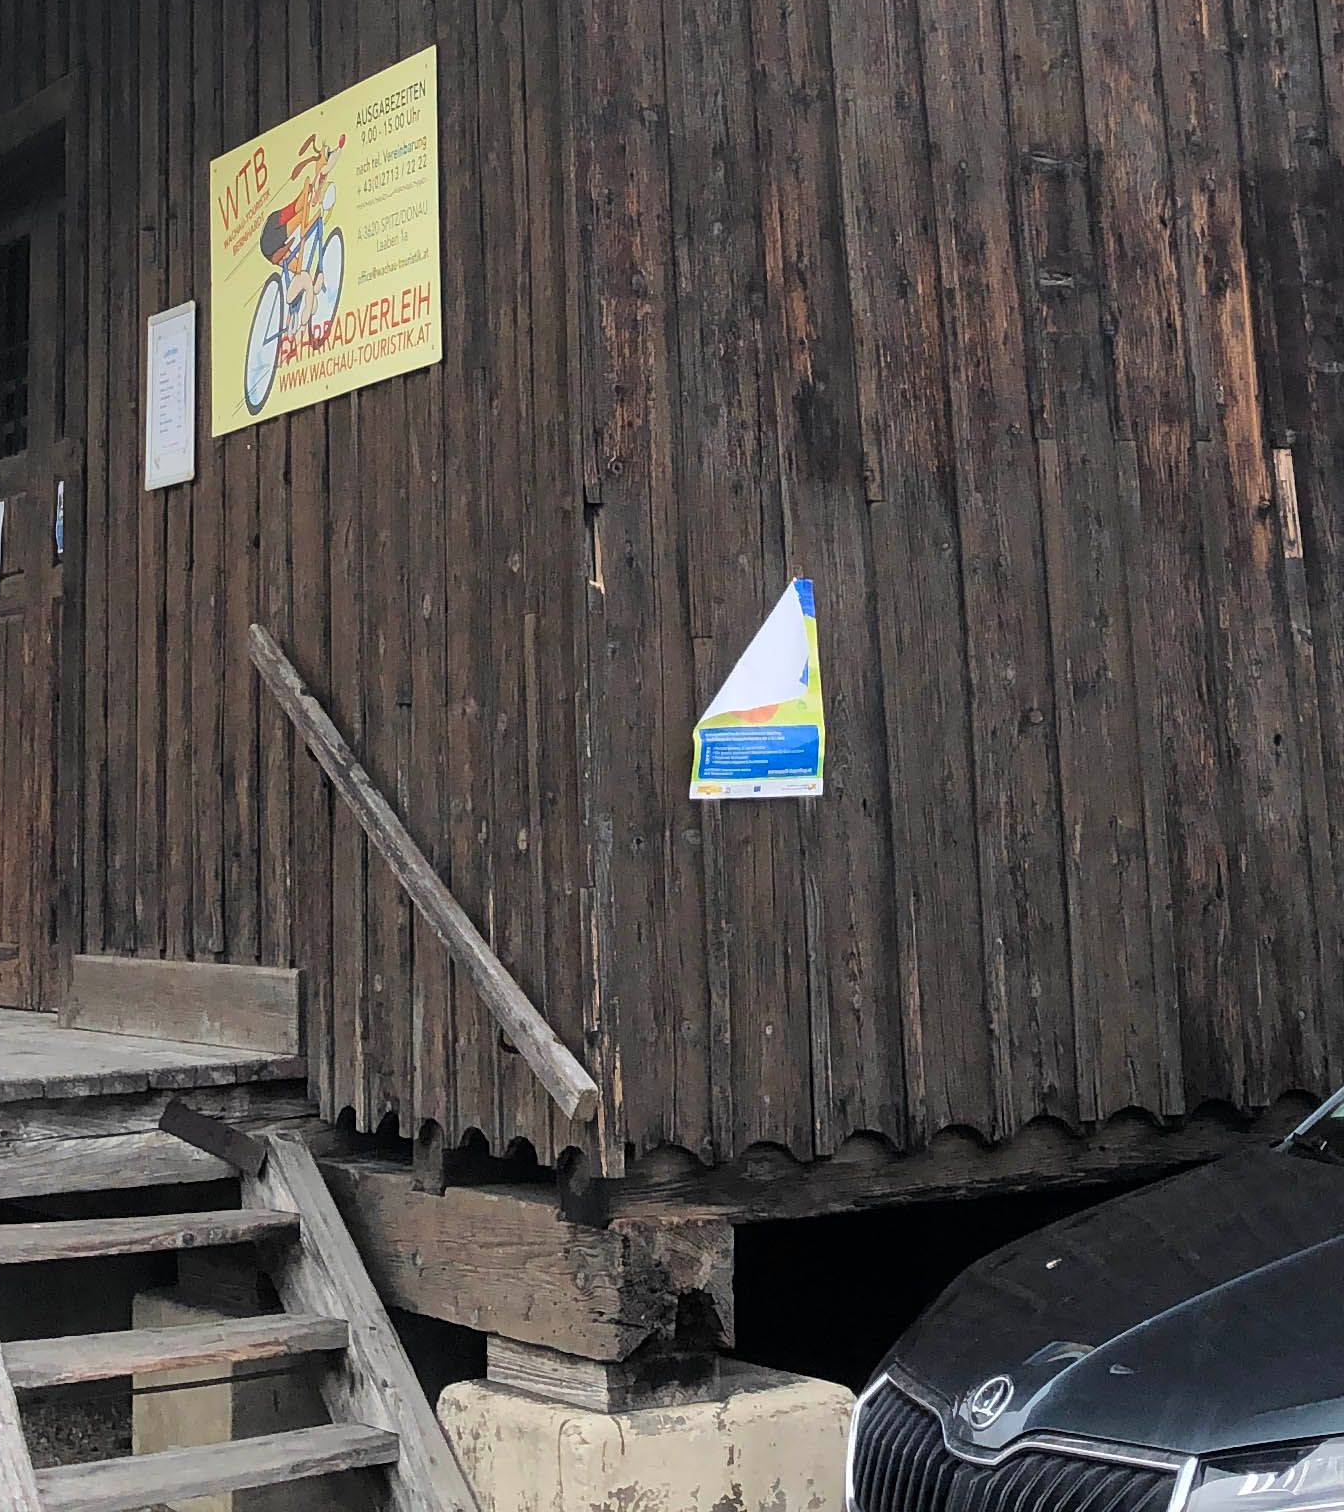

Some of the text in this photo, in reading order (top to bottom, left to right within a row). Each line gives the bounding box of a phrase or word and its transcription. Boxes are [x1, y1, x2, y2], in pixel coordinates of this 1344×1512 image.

[356, 79, 426, 128] AUSGABEZEITEN
[384, 112, 405, 136] 15.00
[406, 106, 421, 126] Uhr
[356, 157, 371, 176] nach
[383, 136, 427, 163] Vereinbarung
[218, 146, 268, 231] WTB
[278, 281, 431, 368] FAHRRADVERLEIH
[279, 322, 432, 393] WWW.WACHAU-TOURISTIK.AT
